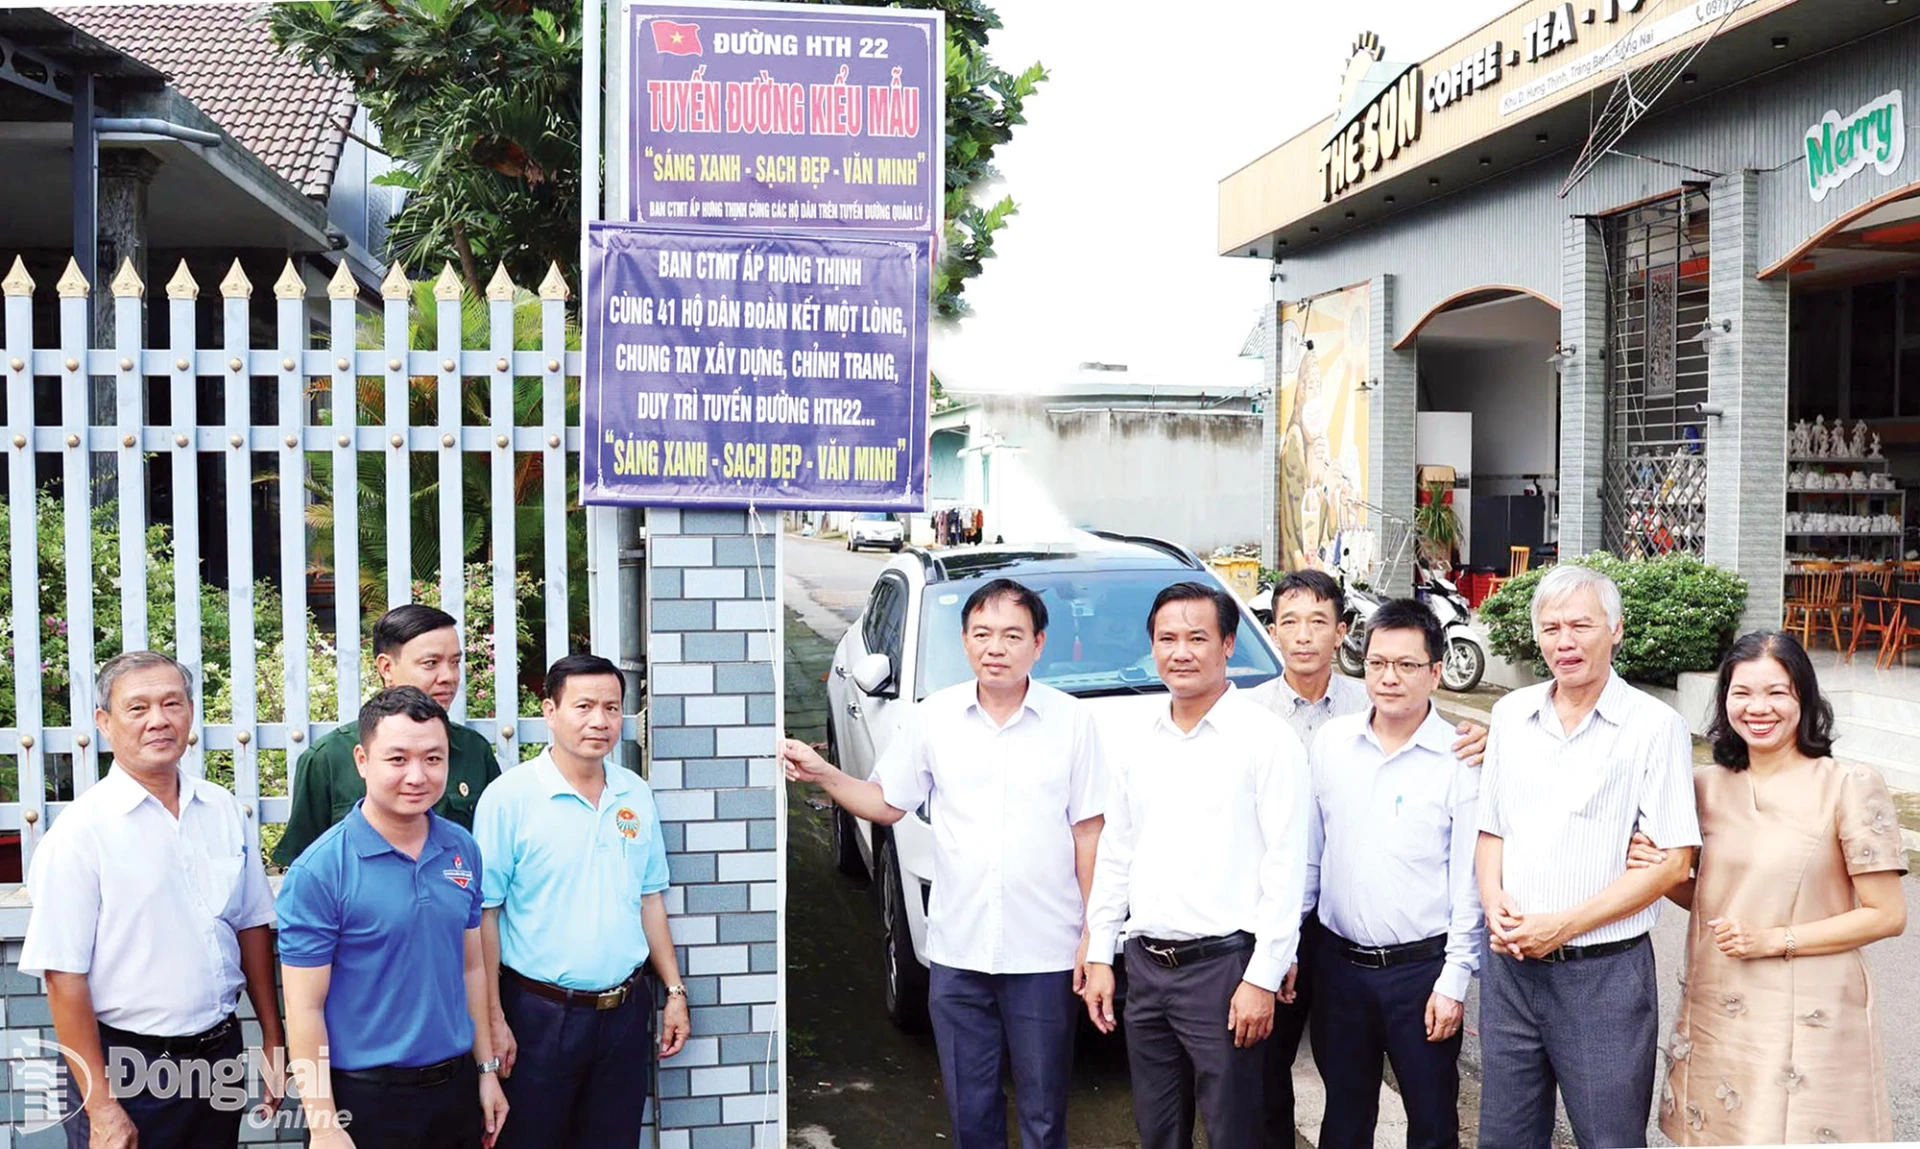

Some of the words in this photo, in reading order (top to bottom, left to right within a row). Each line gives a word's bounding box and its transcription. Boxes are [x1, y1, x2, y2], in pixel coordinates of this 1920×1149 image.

[713, 28, 798, 57] ĐƯỜNG
[806, 36, 850, 58] HTH
[858, 38, 888, 58] 22
[1640, 29, 1654, 46] Nai
[648, 64, 721, 133] TUYẾN
[726, 70, 805, 134] ĐƯỜNG
[810, 64, 862, 136] KIỂU
[868, 66, 919, 138] MẪU
[1318, 120, 1364, 202] THE
[1362, 66, 1423, 172] SUN
[1424, 41, 1500, 112] COFFEE
[1523, 2, 1576, 62] TEA
[1806, 104, 1892, 188] Merry
[700, 155, 740, 182] XANH
[756, 156, 796, 188] SẠCH
[800, 156, 830, 190] ĐẸP
[843, 152, 873, 184] VĂN
[650, 202, 666, 216] BAN
[668, 202, 688, 217] CTMT
[690, 196, 700, 217] ẤP
[702, 200, 722, 218] HƯNG
[724, 202, 746, 220] THỊNH
[748, 200, 770, 218] CÙNG
[772, 200, 786, 218] CÁC
[788, 200, 799, 222] HỘ
[801, 200, 816, 218] DÂN
[818, 200, 838, 218] TRÊN
[840, 200, 863, 220] TUYẾN
[865, 201, 890, 220] ĐƯỜNG
[892, 200, 912, 222] QUẢN
[914, 202, 924, 220] LÝ
[658, 250, 692, 278] BAN
[697, 252, 738, 280] CTMT
[743, 246, 764, 281] ẤP
[768, 254, 811, 283] HƯNG
[816, 257, 862, 291] THỊNH
[610, 291, 652, 324] CÙNG
[658, 300, 674, 325] 41
[682, 294, 702, 333] HỘ
[708, 296, 740, 328] DÂN
[744, 297, 785, 330] ĐOÀN
[792, 296, 820, 331] KẾT
[824, 300, 858, 338] MỘT
[862, 300, 907, 338] LÒNG,
[616, 344, 670, 373] CHUNG
[674, 346, 700, 374] TAY
[704, 342, 736, 374] XÂY
[740, 348, 787, 382] DỰNG,
[792, 342, 839, 379] CHỈNH
[844, 353, 898, 384] TRANG,
[638, 392, 669, 420] DUY
[674, 388, 698, 421] TRÌ
[703, 386, 751, 423] TUYẾN
[756, 394, 808, 424] ĐƯỜNG
[814, 399, 875, 426] HTH22...
[663, 442, 708, 477] XANH
[723, 443, 766, 486] SẠCH
[771, 444, 802, 487] ĐẸP
[818, 438, 850, 480] VĂN
